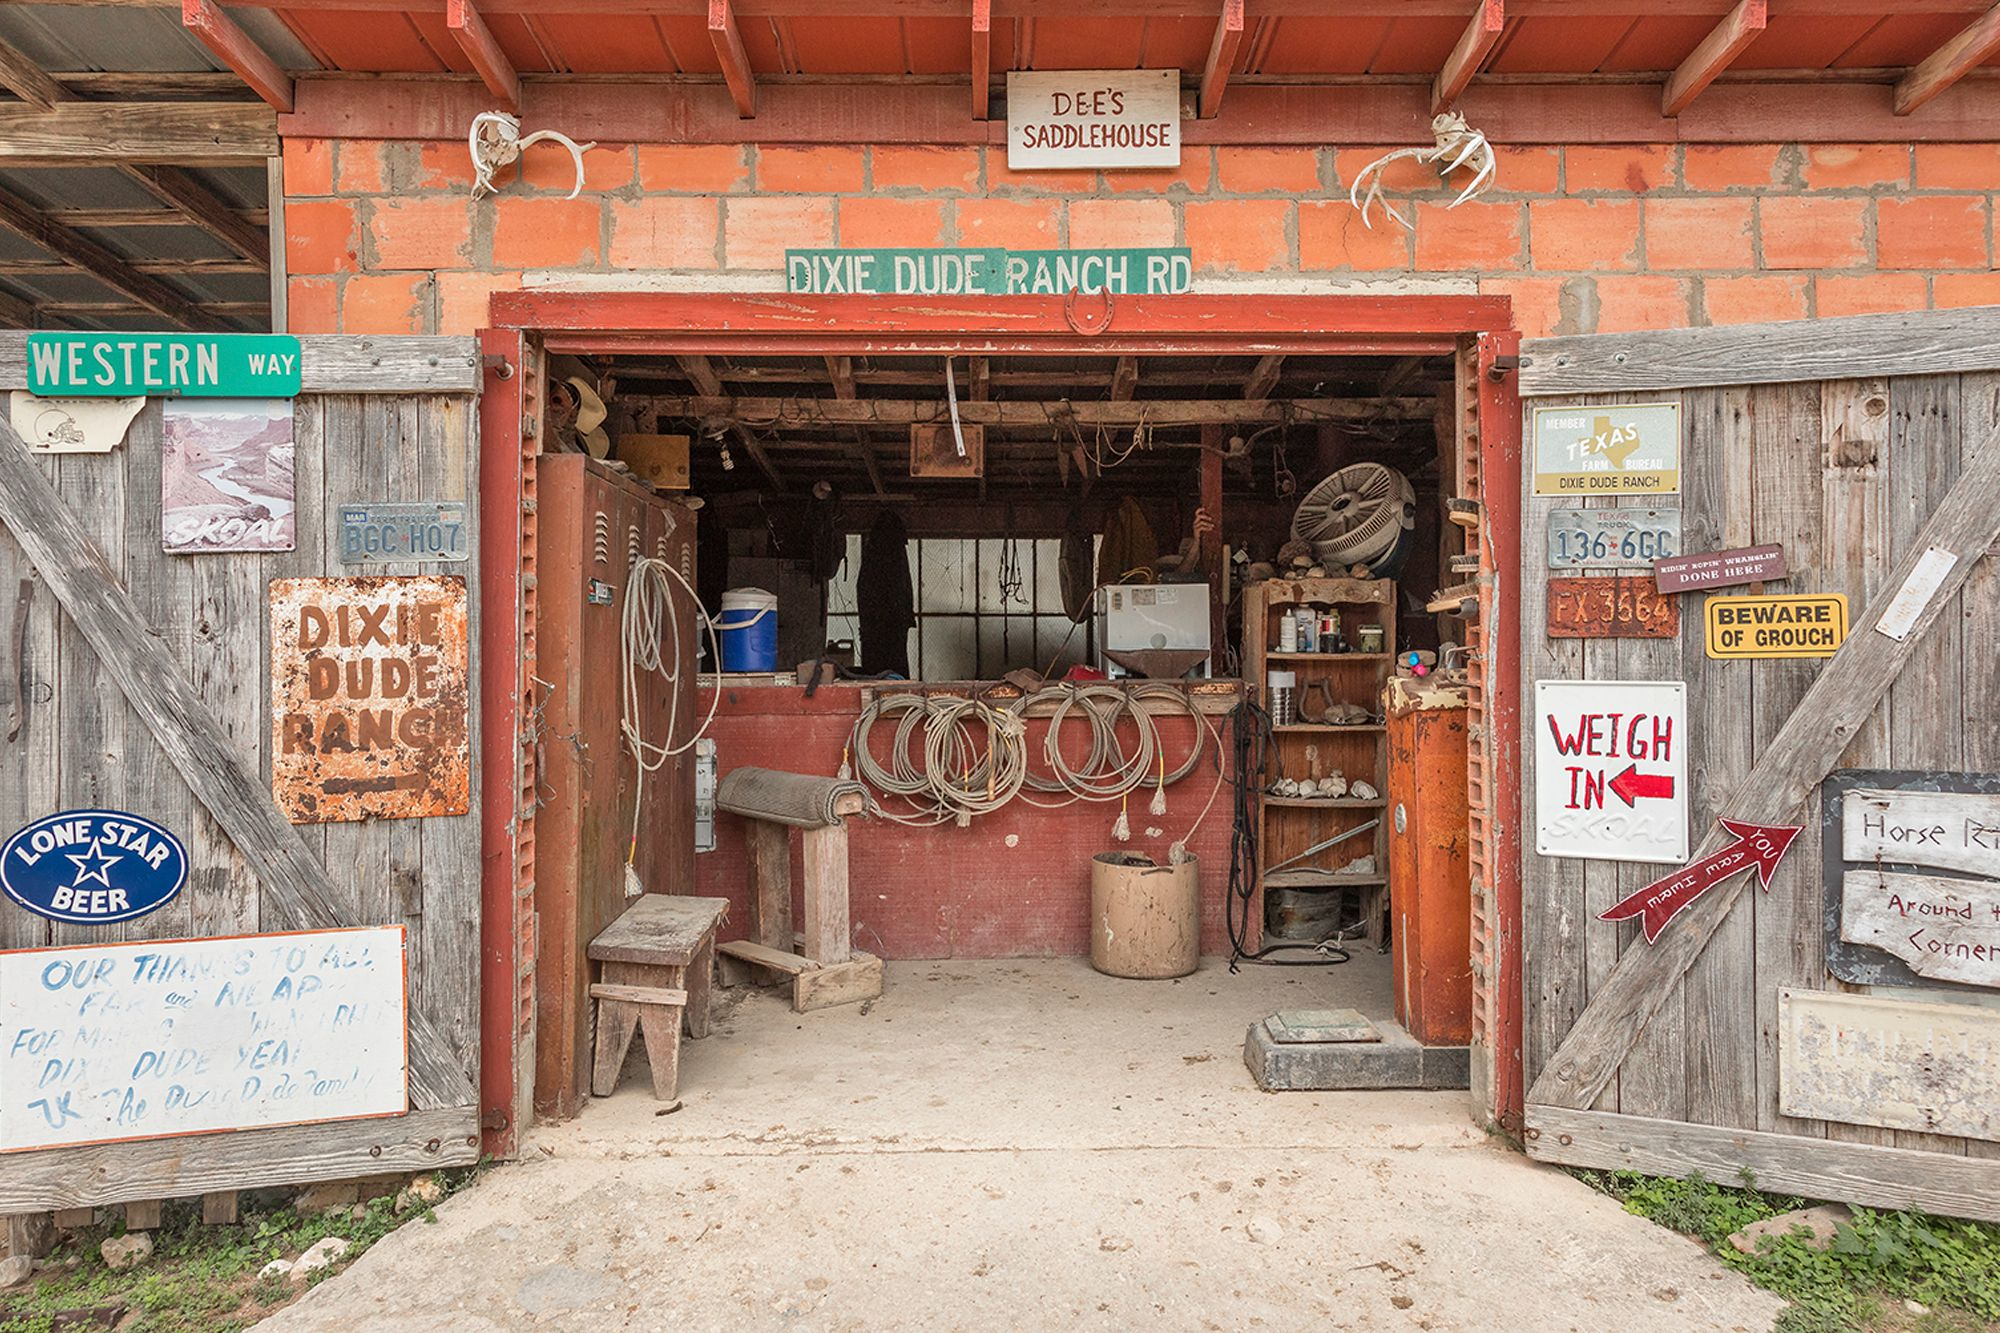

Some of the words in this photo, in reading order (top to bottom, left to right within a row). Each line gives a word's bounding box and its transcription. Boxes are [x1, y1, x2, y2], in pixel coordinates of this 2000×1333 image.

[1052, 87, 1124, 116] DEE'S
[1022, 123, 1171, 149] SADDLEHOUSE
[789, 254, 877, 294] DIXIE
[894, 254, 986, 294] DUDE
[1007, 255, 1128, 294] RANCH
[1147, 255, 1192, 294] RD
[32, 341, 218, 386] WESTERN
[248, 353, 295, 376] WAY
[1545, 417, 1586, 430] MEMBER
[1566, 422, 1637, 461] TEXAS
[1582, 460, 1609, 471] FARM
[1625, 459, 1663, 470] BUREAU
[1560, 477, 1585, 489] DIXIE
[1590, 476, 1618, 489] DUDE
[1623, 476, 1660, 488] RANCH
[168, 518, 289, 546] SKOAL
[345, 524, 397, 553] BGC
[1556, 530, 1607, 561] 136
[1621, 529, 1673, 560] 6GC
[1680, 569, 1720, 583] DONE
[1725, 563, 1763, 578] HERE
[299, 603, 442, 650] DIXIE
[1718, 604, 1831, 626] BEWARE
[1720, 631, 1744, 648] OF
[1755, 627, 1834, 647] GROUCH
[308, 656, 438, 701] DUDE
[1547, 713, 1673, 762] WEIGH
[1564, 766, 1605, 810] IN
[1549, 812, 1676, 844] SKOAL
[1750, 828, 1779, 860] YOU
[1863, 813, 1946, 845] Horse
[15, 819, 92, 867] LONE
[99, 821, 170, 871] STAR
[1705, 851, 1745, 876] ARE
[50, 884, 130, 914] BEER
[1647, 874, 1697, 909] HERE
[1888, 894, 1972, 919] Around
[1908, 928, 2000, 962] Corner
[41, 957, 116, 991] OUR
[132, 950, 256, 985] THANS
[131, 1049, 211, 1081] DUDE
[234, 1038, 303, 1072] YEA
